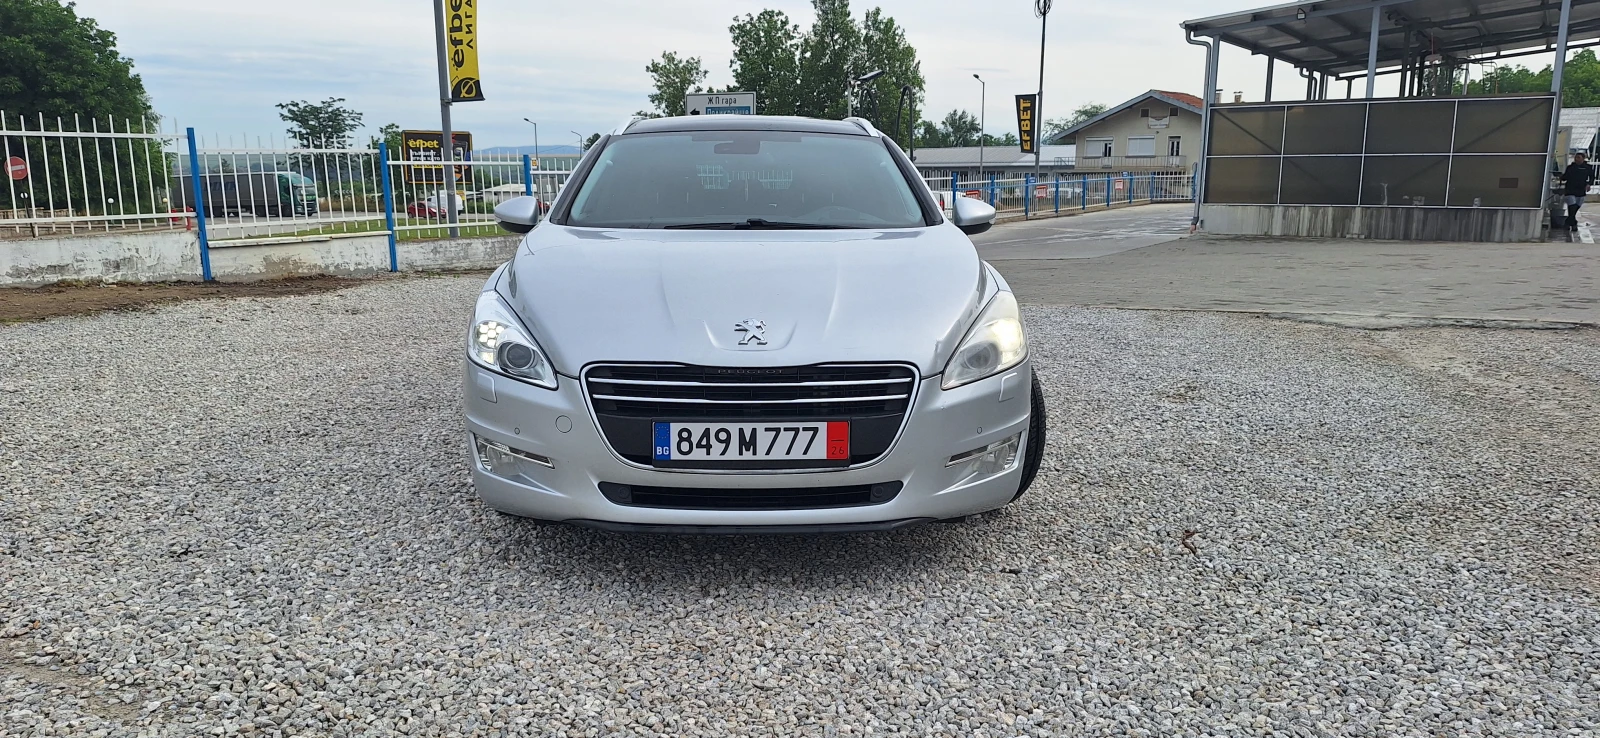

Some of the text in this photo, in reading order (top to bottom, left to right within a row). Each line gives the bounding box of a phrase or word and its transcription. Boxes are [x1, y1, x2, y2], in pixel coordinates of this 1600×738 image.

[721, 97, 737, 106] гара
[1020, 98, 1031, 150] EFBET
[656, 446, 669, 455] BG
[831, 446, 845, 455] 26
